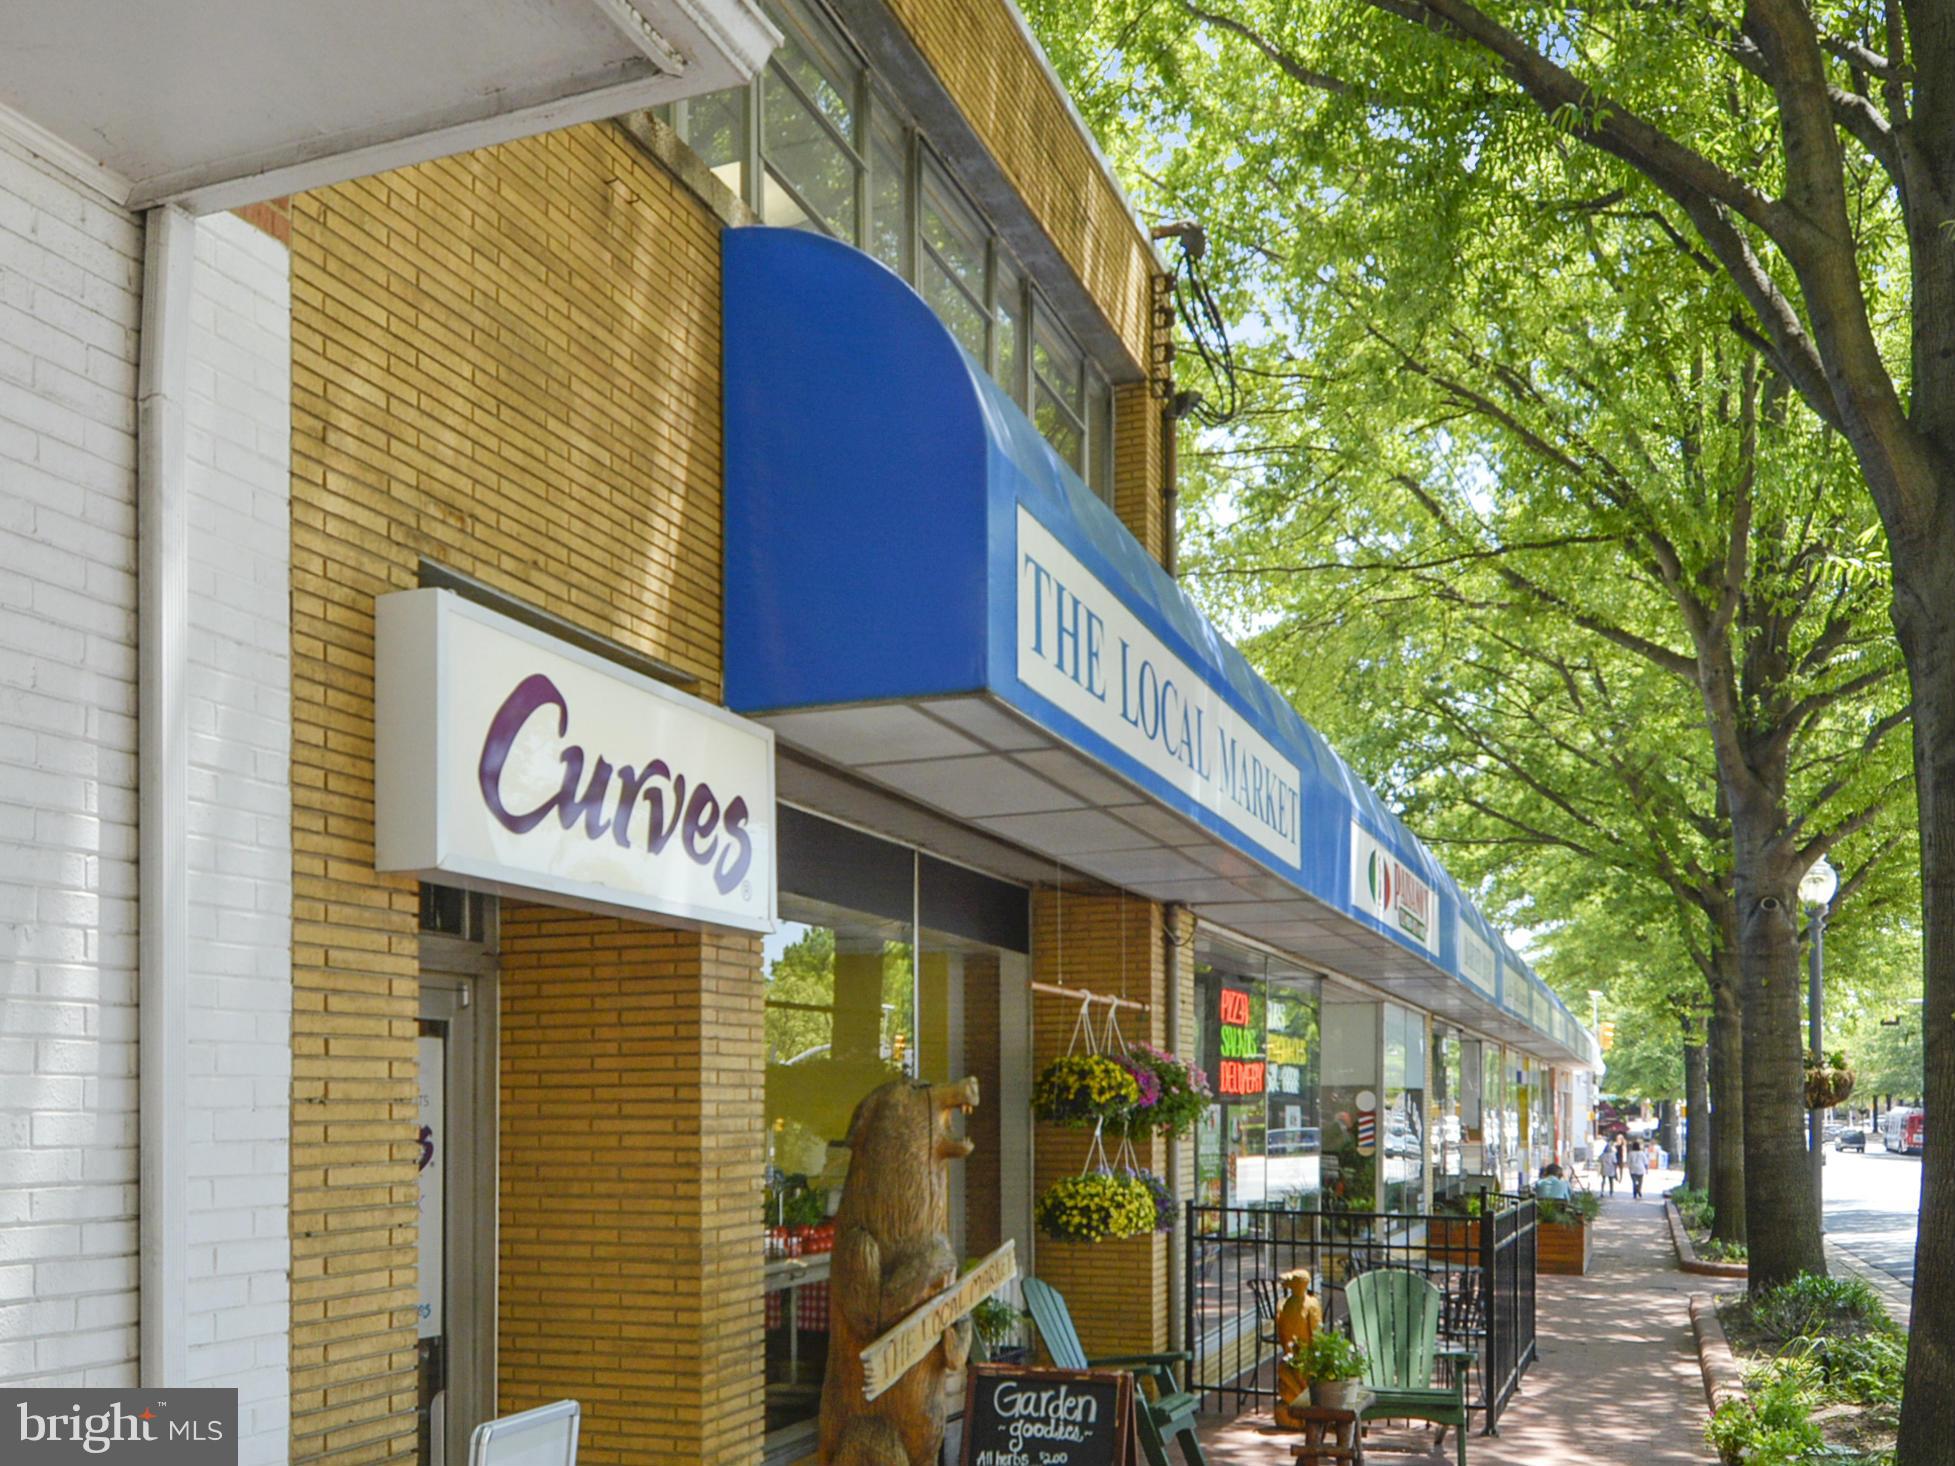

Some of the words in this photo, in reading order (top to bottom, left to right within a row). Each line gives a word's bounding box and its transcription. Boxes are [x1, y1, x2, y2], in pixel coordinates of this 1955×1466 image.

[1024, 553, 1107, 703] THE
[1118, 636, 1211, 783] LOCAL
[1218, 725, 1299, 846] MARKET
[478, 673, 753, 896] Curves
[1220, 988, 1250, 1026] PIZZA
[1219, 1060, 1265, 1096] DELIVERY
[993, 1381, 1098, 1423] Garden
[976, 1450, 993, 1466] All
[995, 1450, 1029, 1466] herbs
